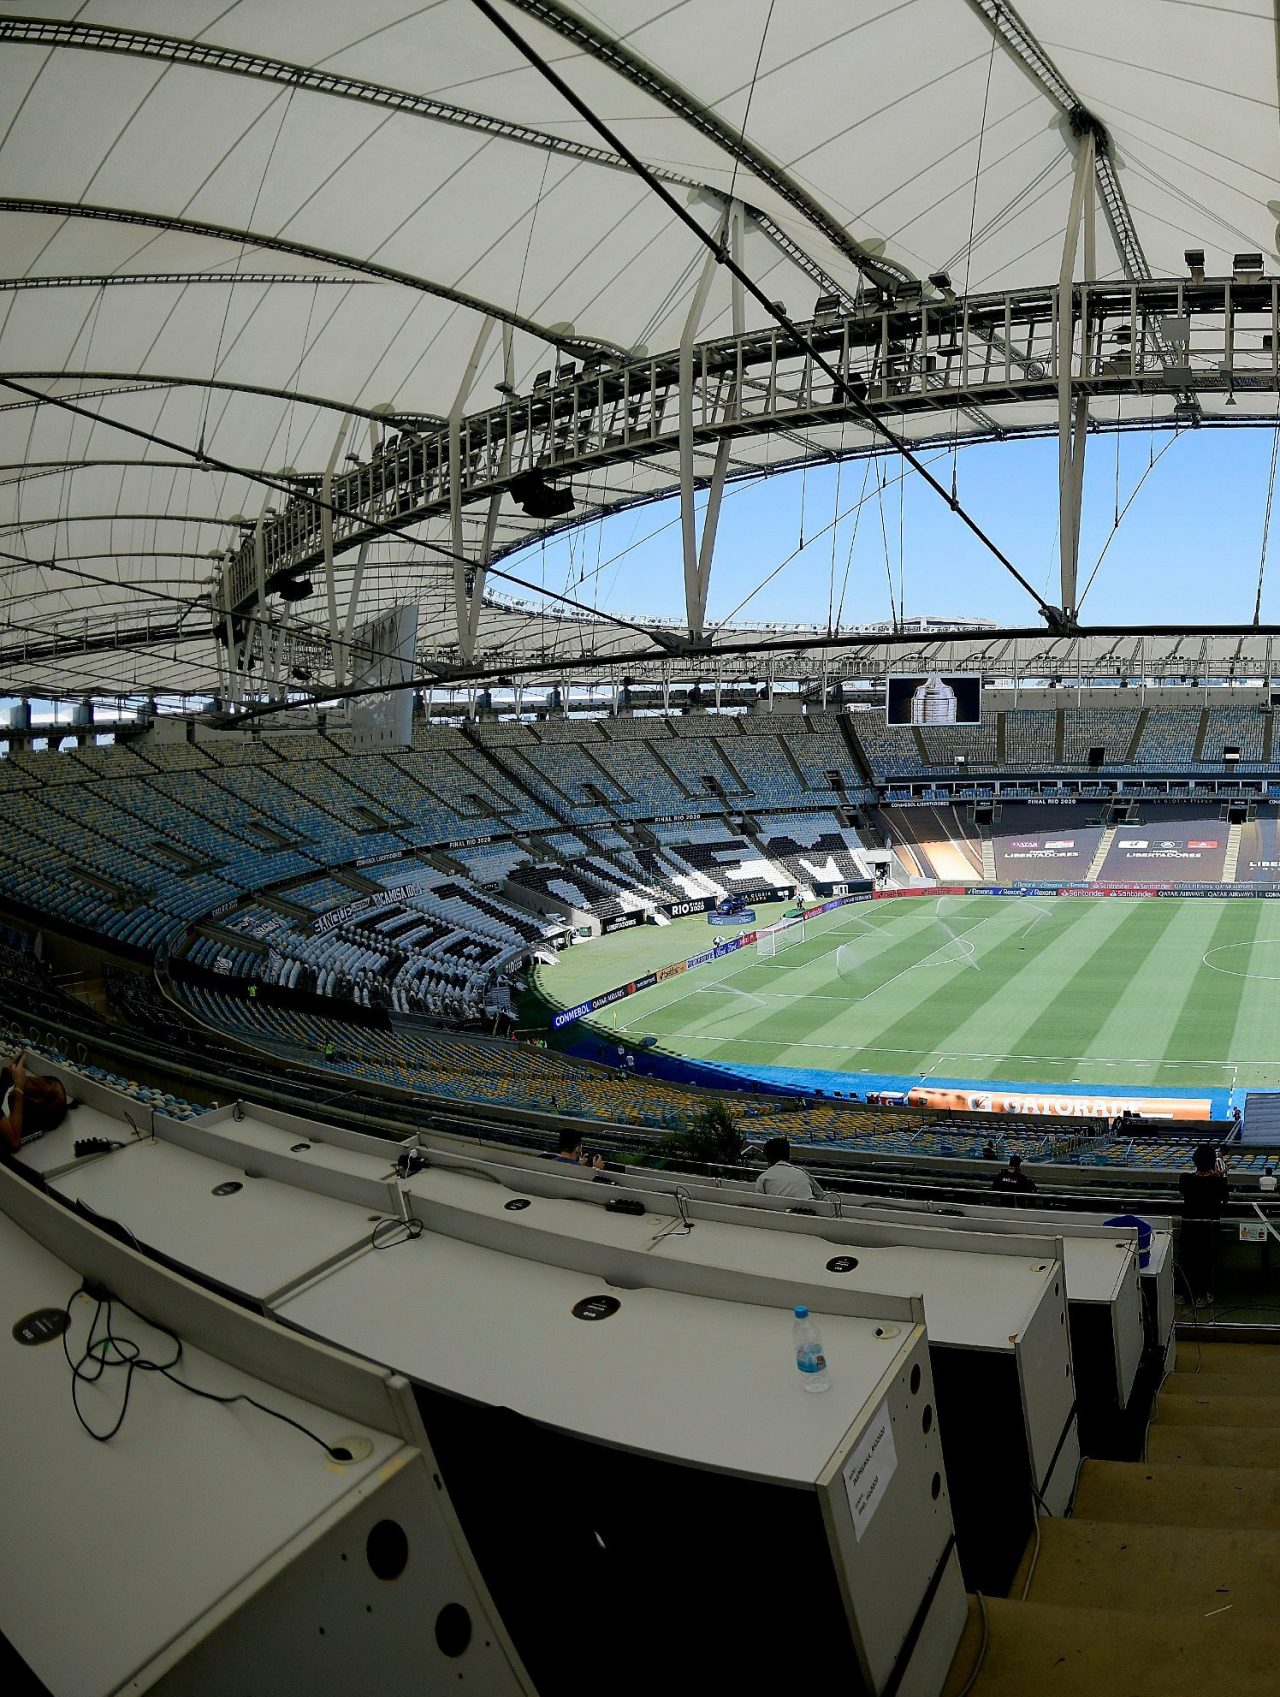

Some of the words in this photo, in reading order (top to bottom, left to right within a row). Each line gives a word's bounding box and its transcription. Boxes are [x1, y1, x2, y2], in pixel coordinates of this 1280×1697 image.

[449, 840, 465, 848] FINAL
[466, 838, 476, 846] RIO
[477, 836, 491, 844] 2020
[380, 888, 406, 907] CAMISA
[1117, 890, 1153, 898] Santander
[672, 904, 689, 916] RIO
[690, 904, 704, 913] 2020
[312, 908, 352, 932] SANGUE
[555, 1003, 590, 1026] CONMEBOL
[1003, 1097, 1144, 1118] GATORADE
